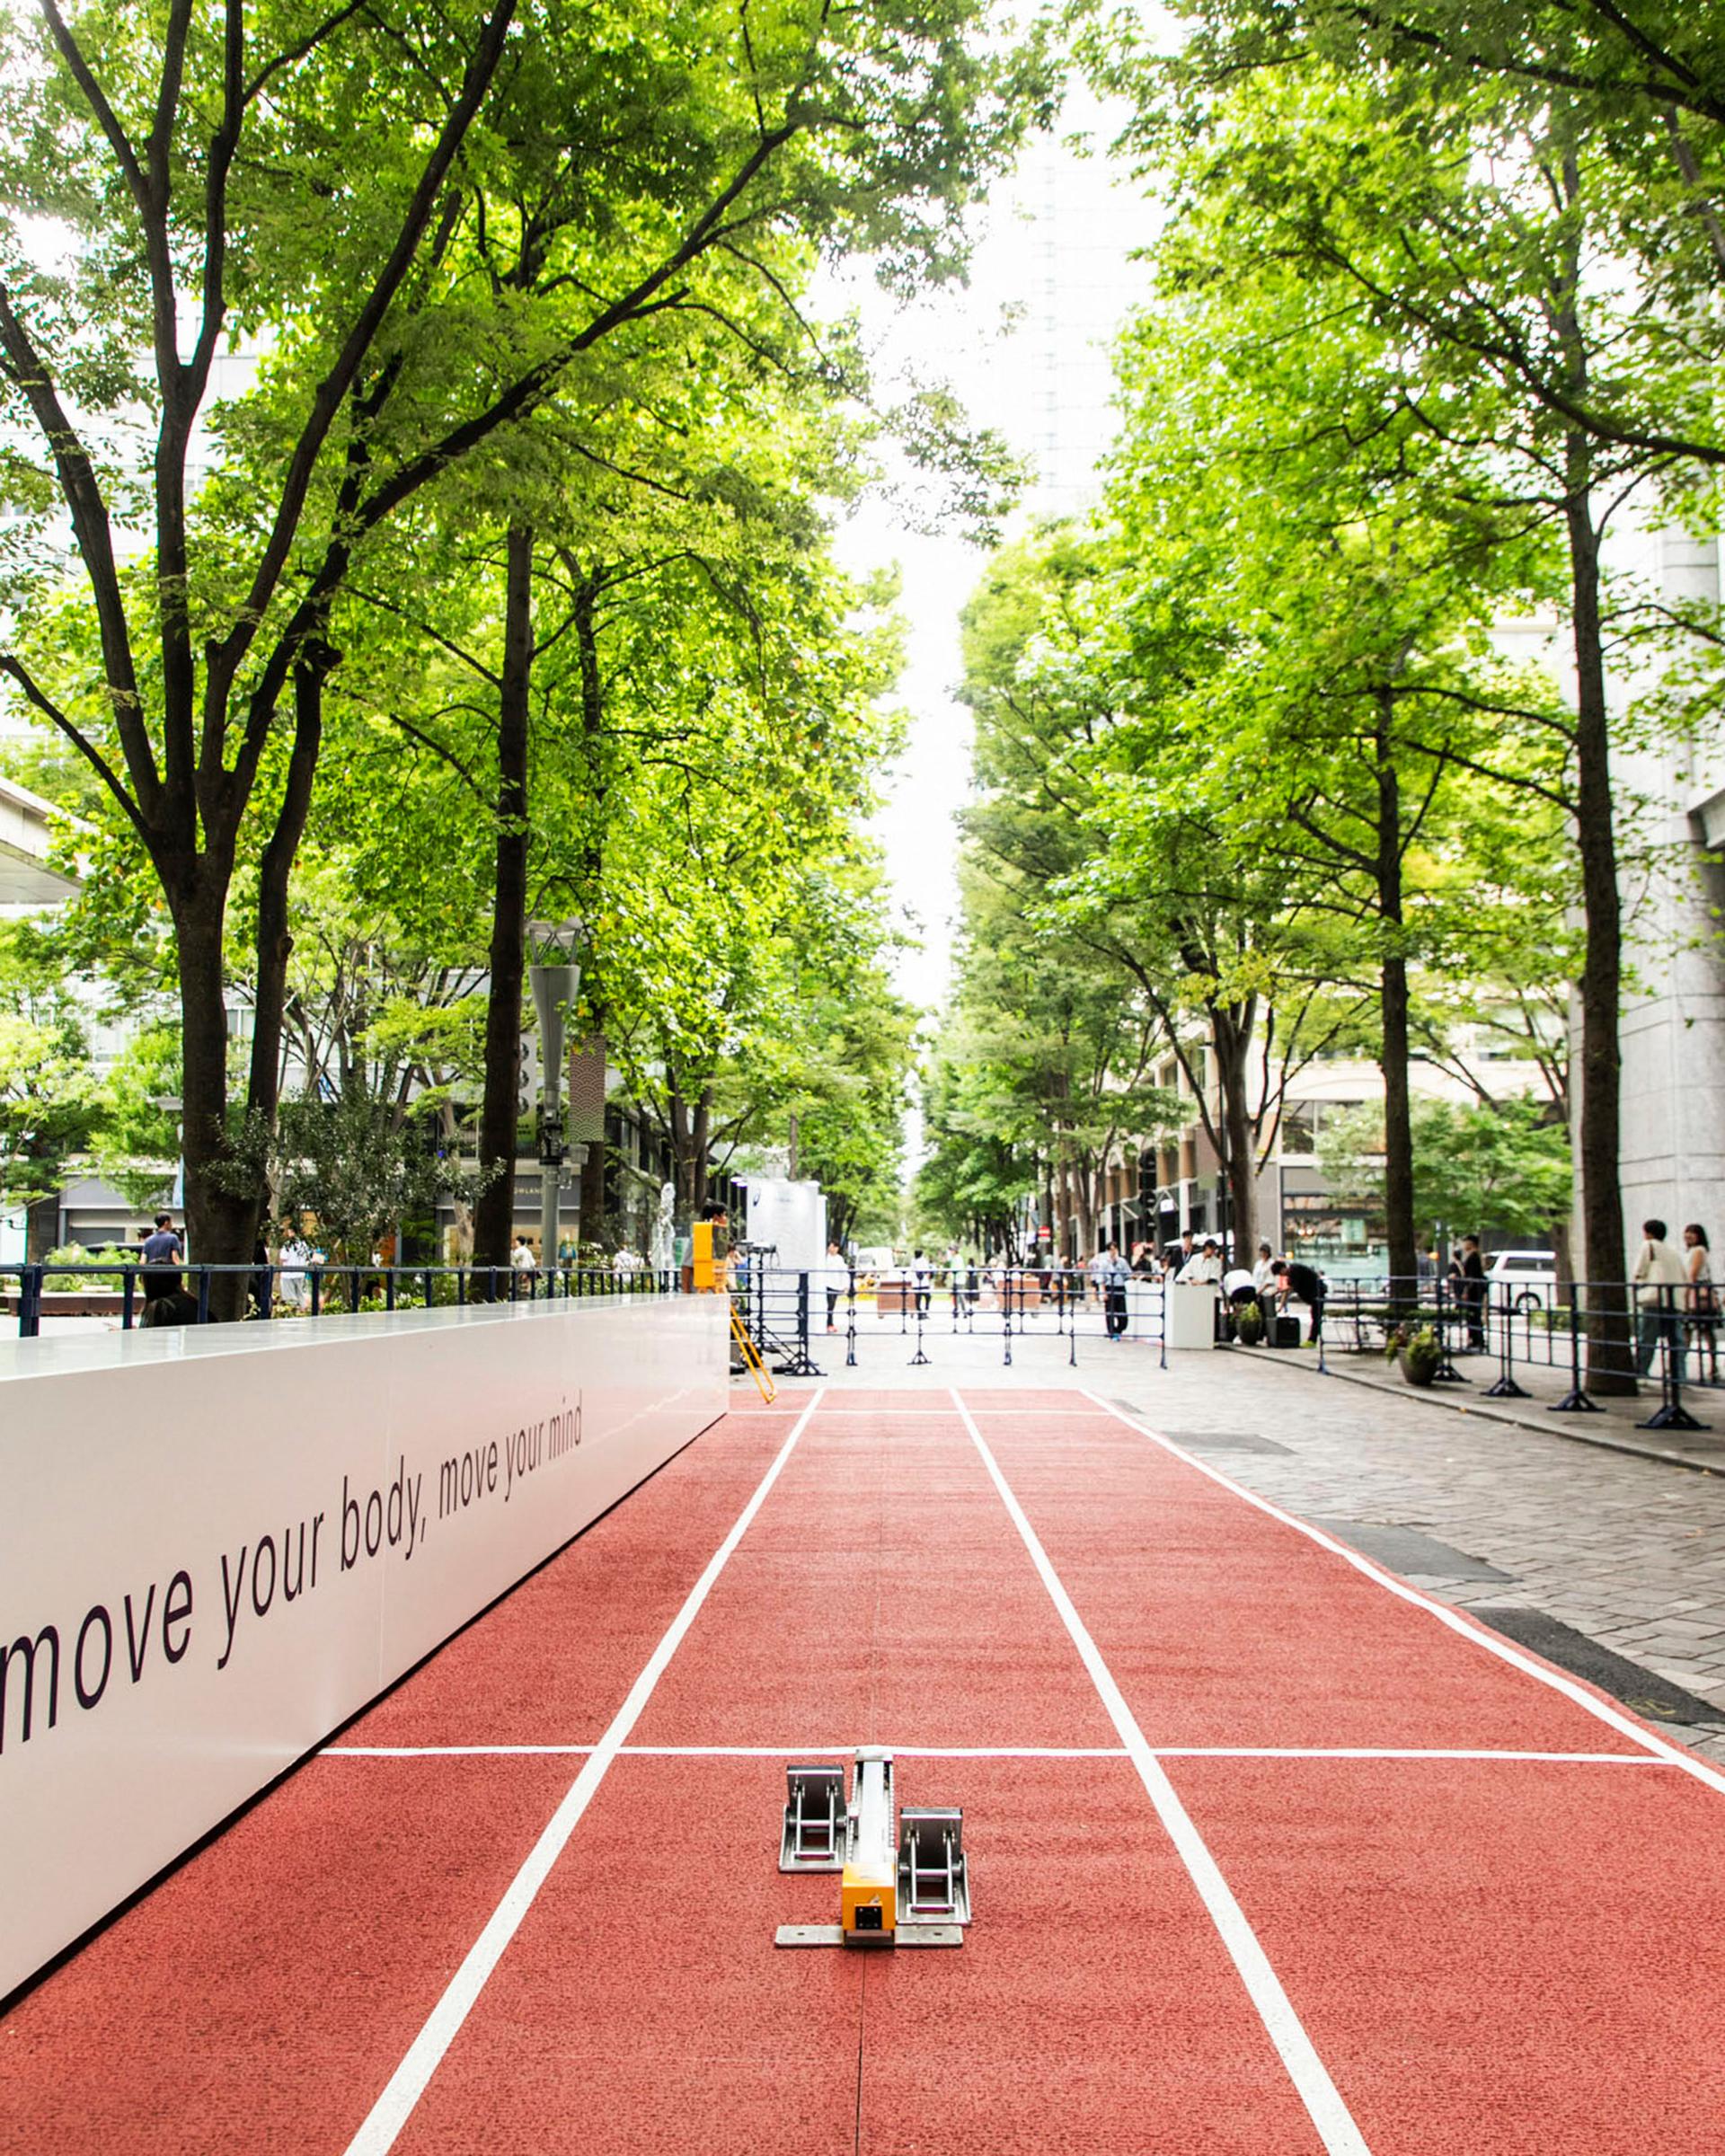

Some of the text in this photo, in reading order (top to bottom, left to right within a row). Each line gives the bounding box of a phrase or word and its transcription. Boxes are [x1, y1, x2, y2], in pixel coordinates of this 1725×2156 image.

[0, 1389, 582, 1755] move your body, move your mind
